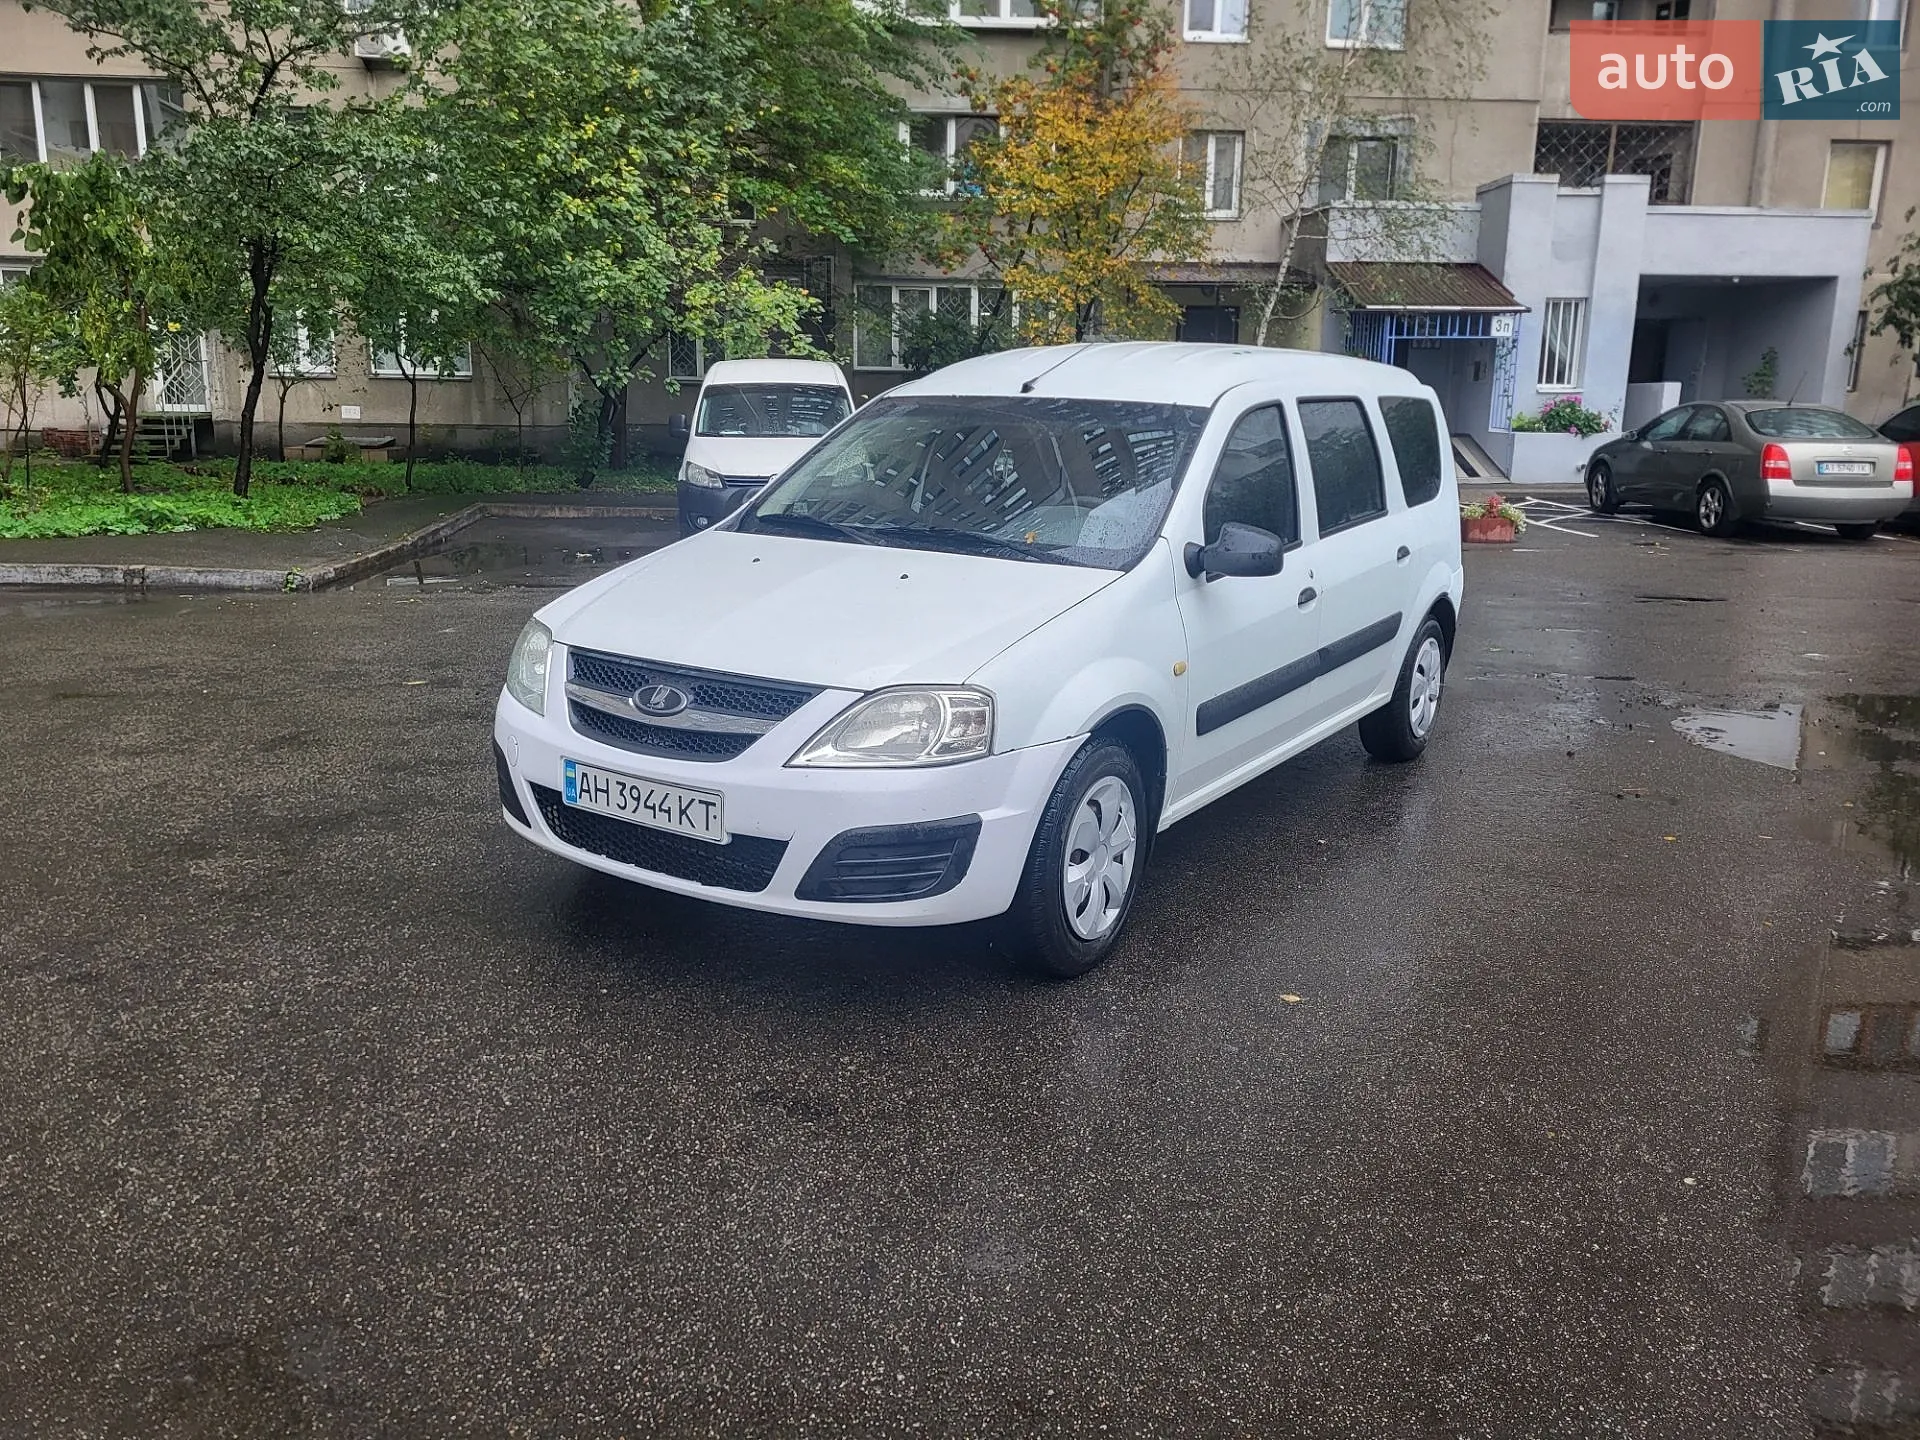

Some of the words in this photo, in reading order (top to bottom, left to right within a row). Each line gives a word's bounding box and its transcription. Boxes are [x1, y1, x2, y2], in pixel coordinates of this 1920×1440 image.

[566, 786, 577, 798] UA
[578, 771, 610, 807] AH
[615, 780, 672, 823] 3944
[678, 795, 717, 831] KT
